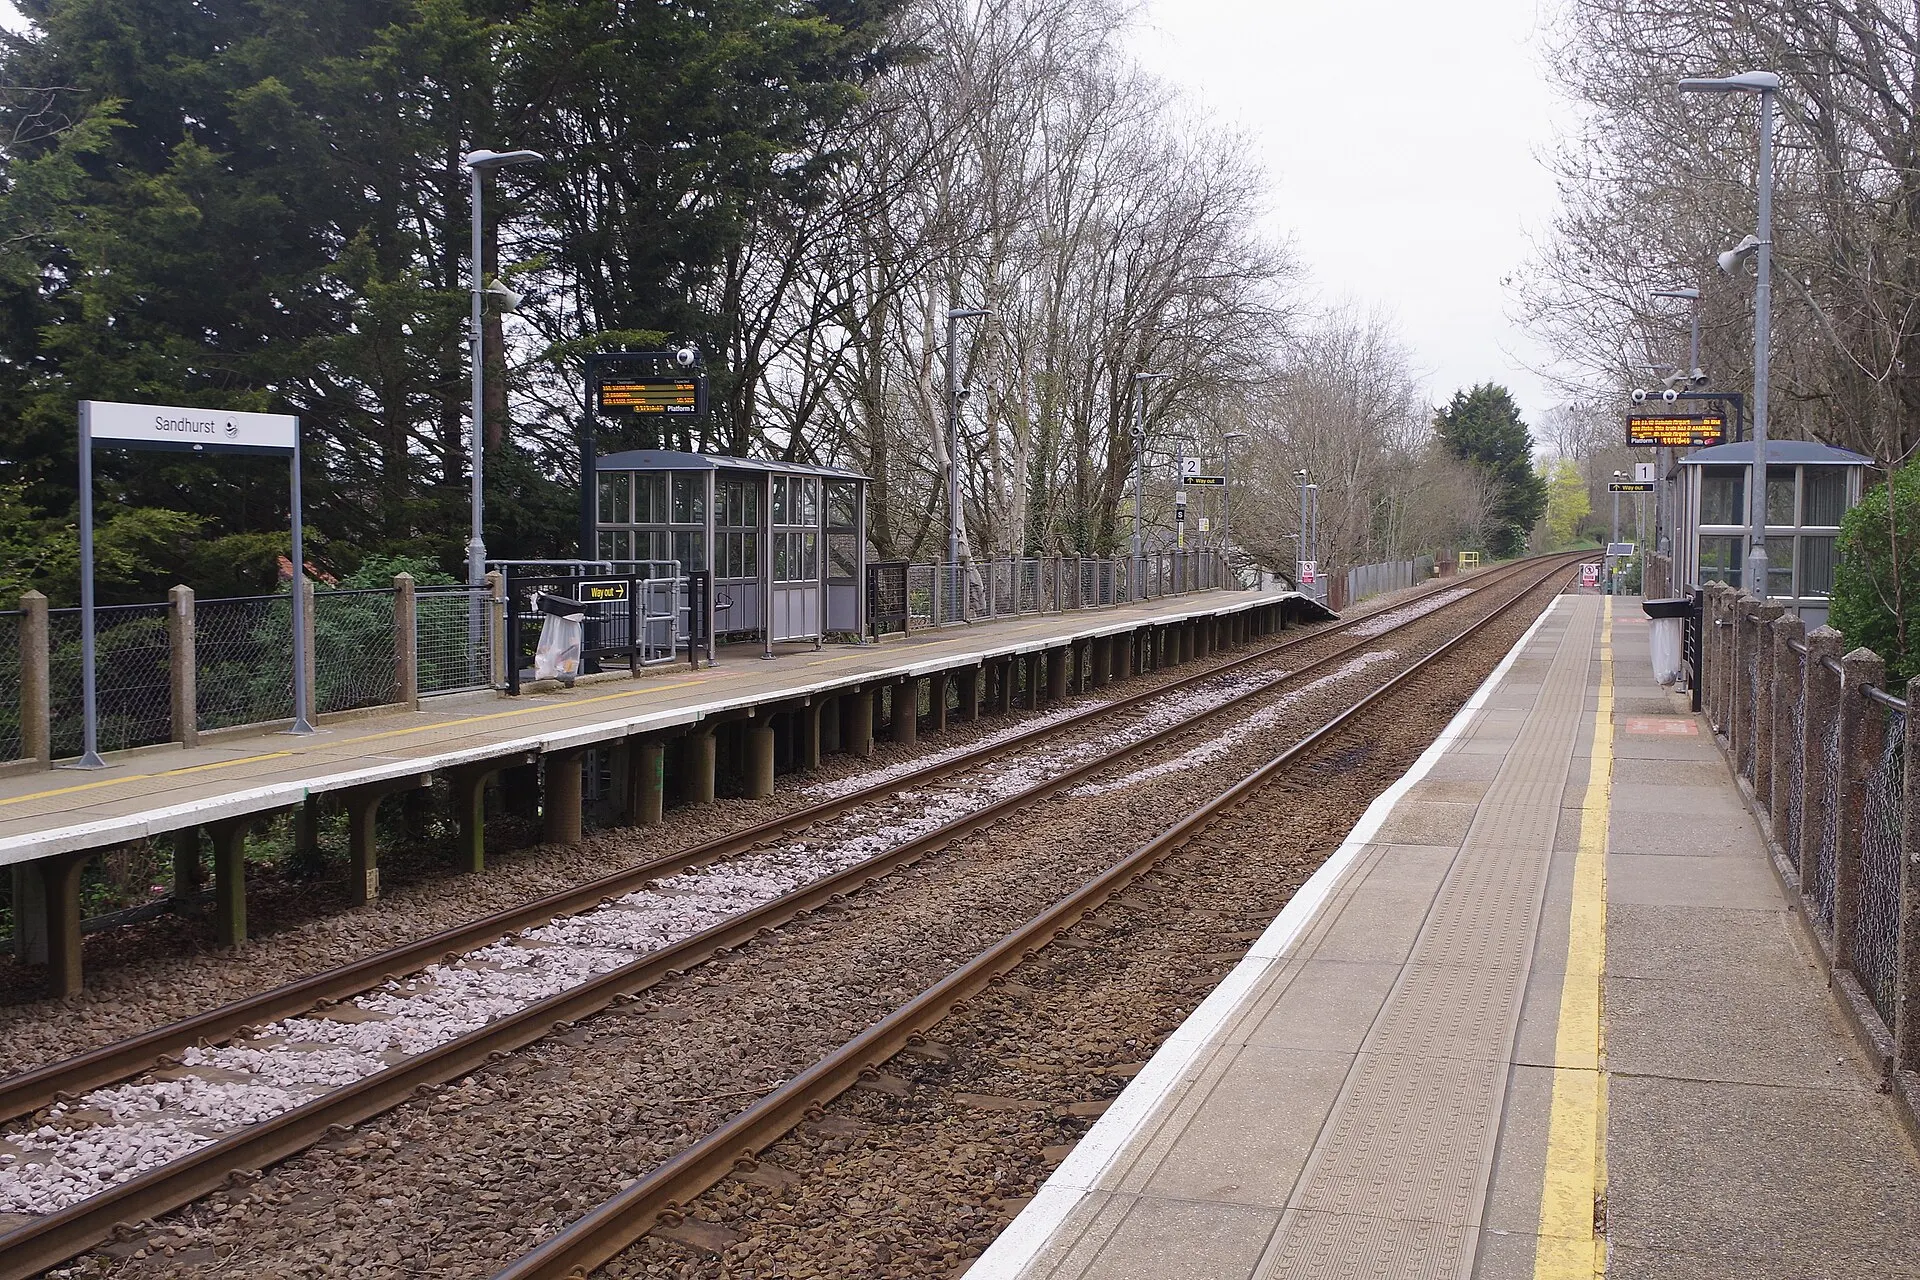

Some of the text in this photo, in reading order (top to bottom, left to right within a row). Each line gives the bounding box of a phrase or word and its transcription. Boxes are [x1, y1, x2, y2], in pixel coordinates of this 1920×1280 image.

[155, 416, 215, 434] Sandhurst
[1187, 460, 1196, 473] 2
[1642, 466, 1647, 479] 1
[591, 587, 614, 599] Way out
